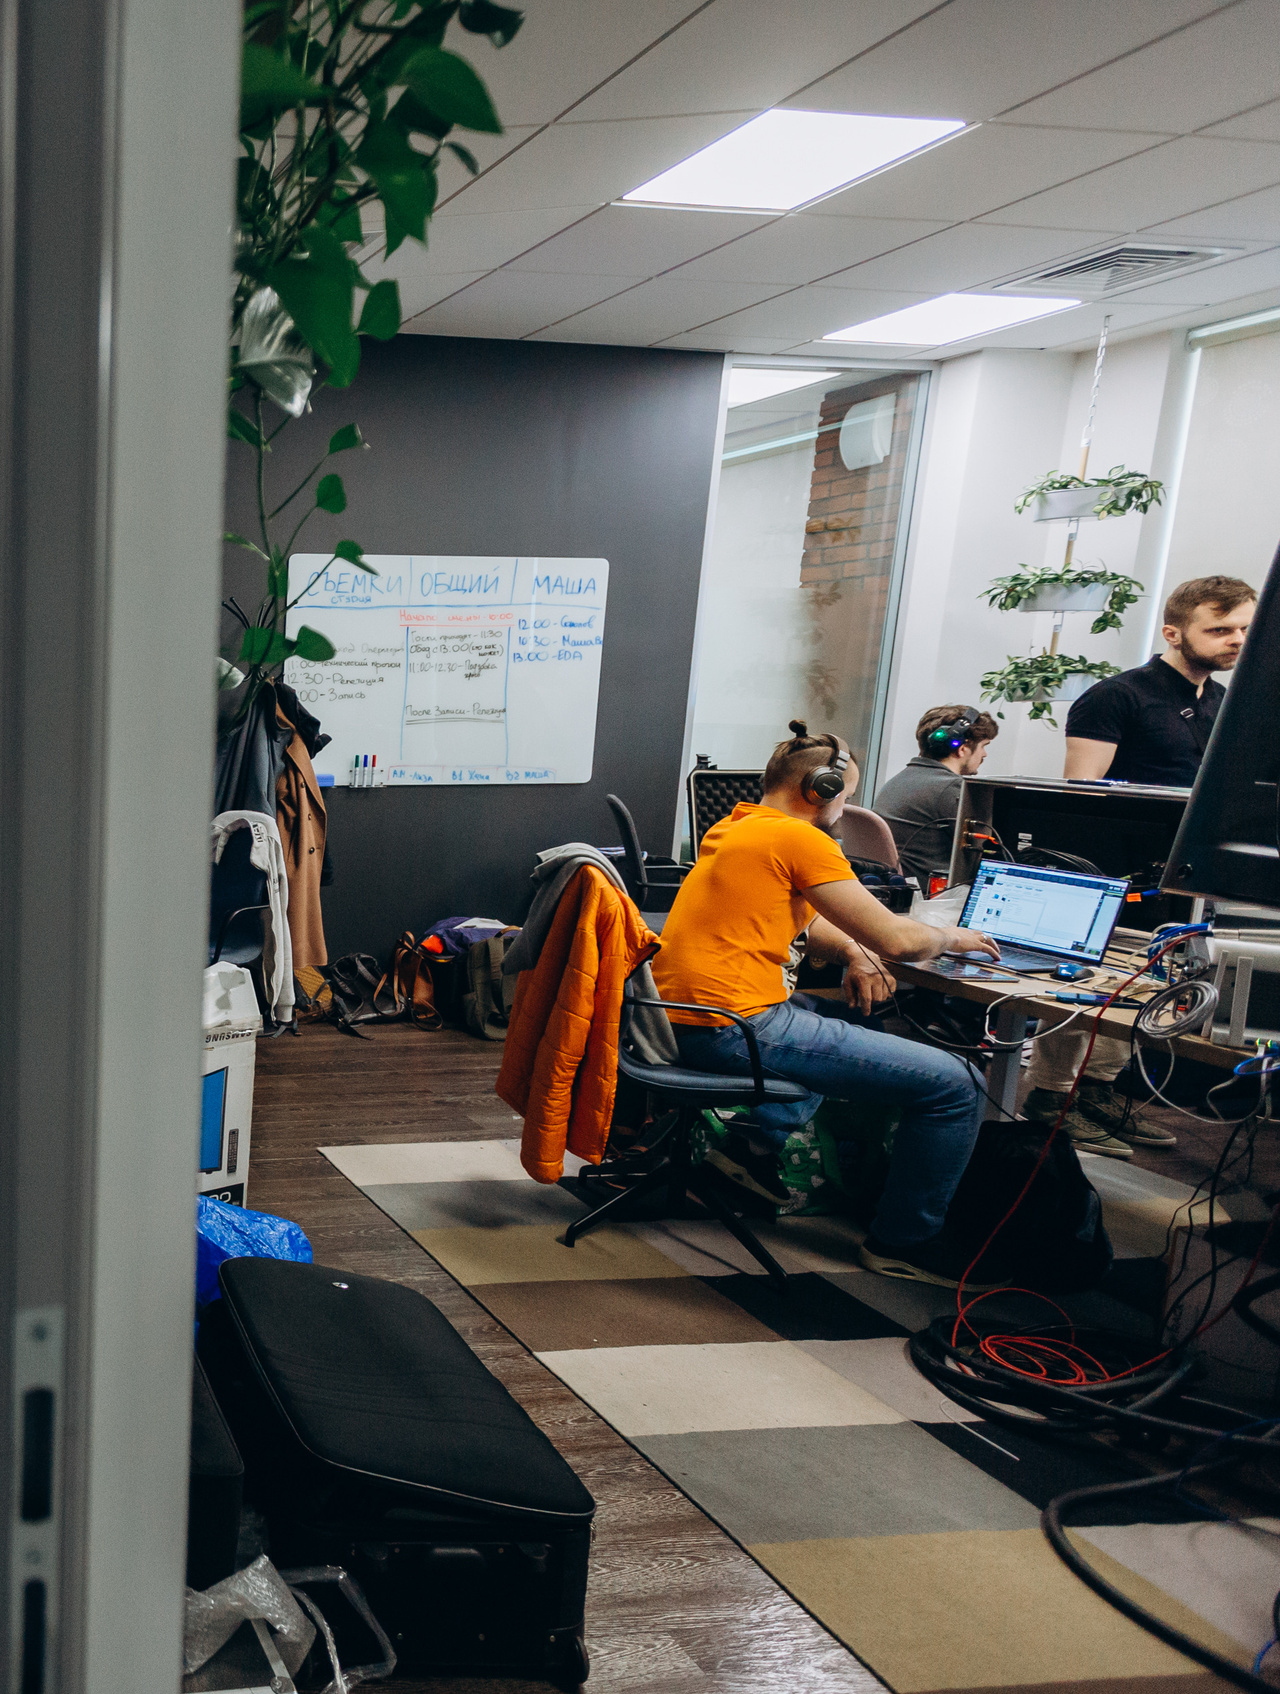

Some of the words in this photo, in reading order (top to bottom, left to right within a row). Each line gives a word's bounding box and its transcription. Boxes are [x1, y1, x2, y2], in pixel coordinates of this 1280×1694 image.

[307, 571, 403, 597] СЪЕМКИ
[420, 566, 500, 597] ОБЩИЙ
[532, 575, 596, 595] МАША
[400, 609, 438, 621] Начало
[405, 704, 432, 717] После
